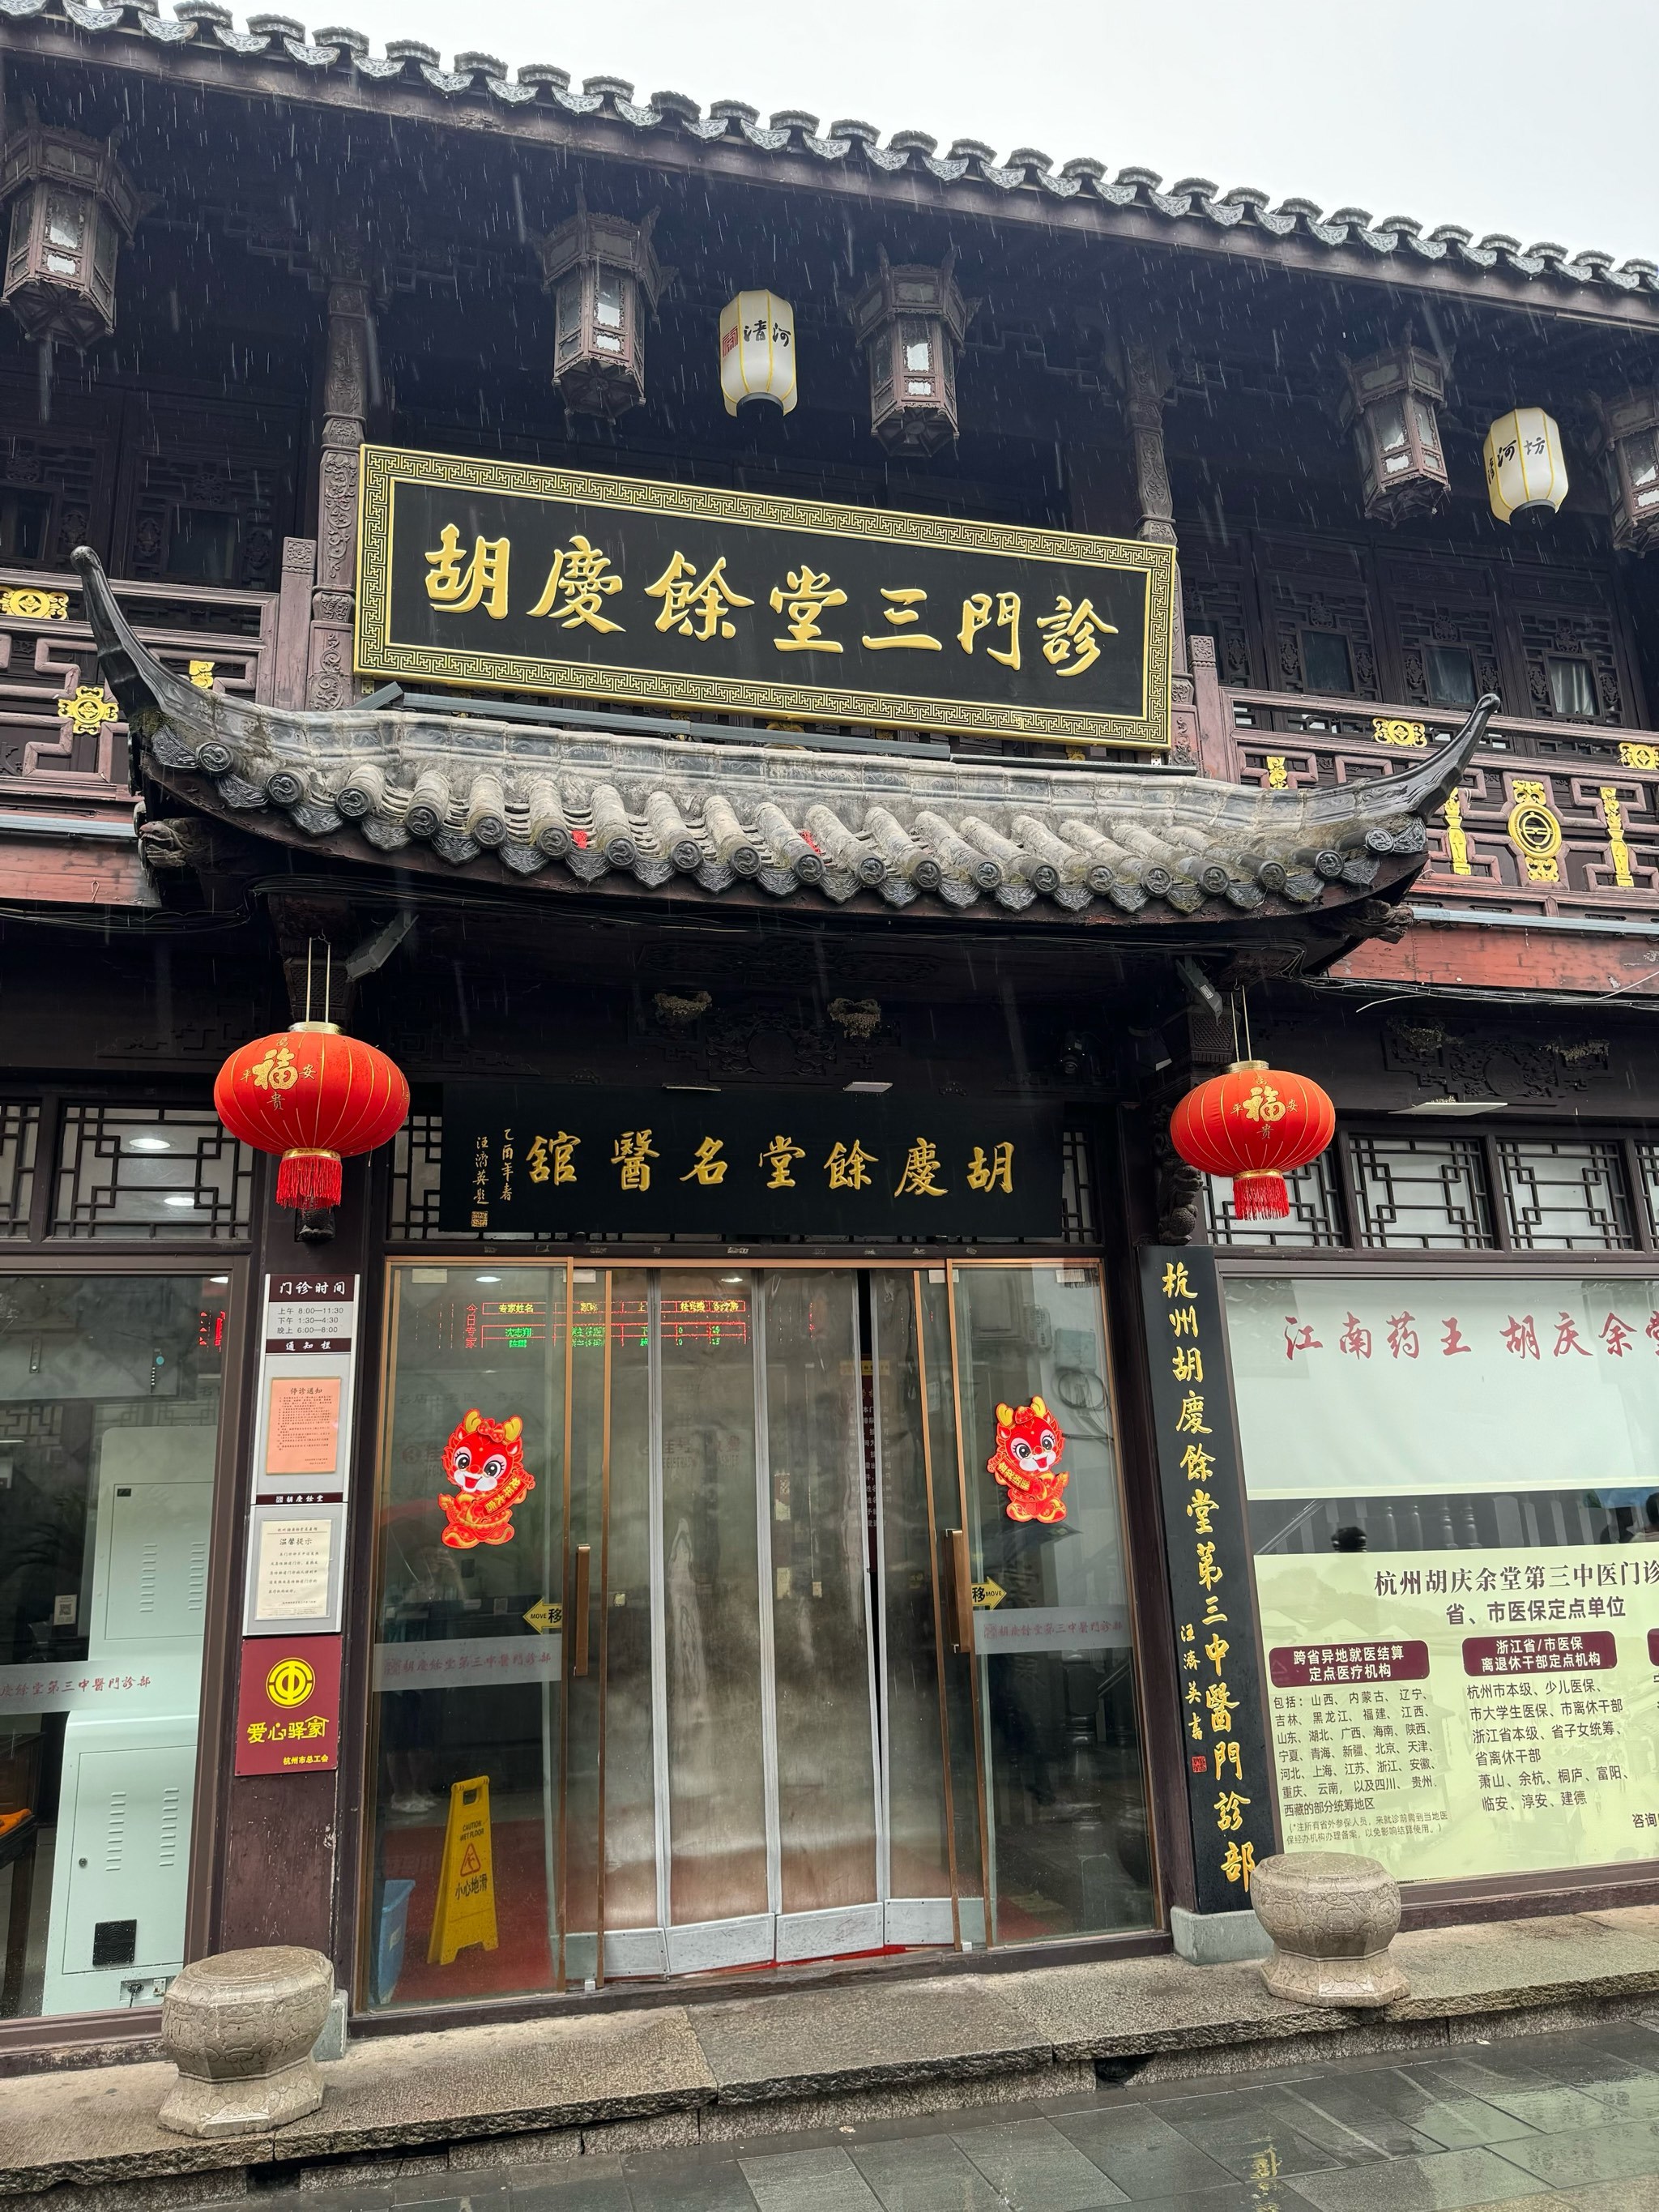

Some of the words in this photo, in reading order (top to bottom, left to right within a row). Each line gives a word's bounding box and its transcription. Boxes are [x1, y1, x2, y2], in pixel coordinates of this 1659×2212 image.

[424, 523, 1119, 678] 胡慶餘堂三門診
[252, 1047, 299, 1090] 福
[1242, 1086, 1286, 1121] 福
[280, 1281, 345, 1295] 门诊时间
[1285, 1311, 1471, 1360] 江南药王
[972, 1586, 985, 1603] 移
[548, 1608, 562, 1623] 移
[1445, 1595, 1626, 1625] 省、市医保定点单位
[1294, 1645, 1404, 1665] 跨省异地就医结算
[1496, 1636, 1583, 1655] 浙江省/市医保
[1481, 1651, 1601, 1672] 离退休干部定点机构
[1309, 1663, 1392, 1683] 定点医疗机构
[1467, 1678, 1602, 1700] 杭州市本级、少儿医保、
[1469, 1698, 1623, 1721] 市大学生医保、市离休干部
[247, 1715, 329, 1744] 爱心驿家
[1472, 1720, 1622, 1744] 浙江省本级、省子女统筹、
[284, 1754, 328, 1765] 杭州市总工会
[1475, 1748, 1541, 1766] 省离休干部
[1478, 1766, 1629, 1789] 萧山、余杭、桐庐、富阳、
[1284, 1797, 1375, 1817] 西藏的部分统筹地区
[1482, 1790, 1587, 1812] 临安、淳安、建德
[463, 1820, 481, 1831] CAUTION
[1632, 1813, 1659, 1828] 咨询
[470, 1828, 484, 1840] FLOOR
[455, 1873, 488, 1900] 小心地滑
